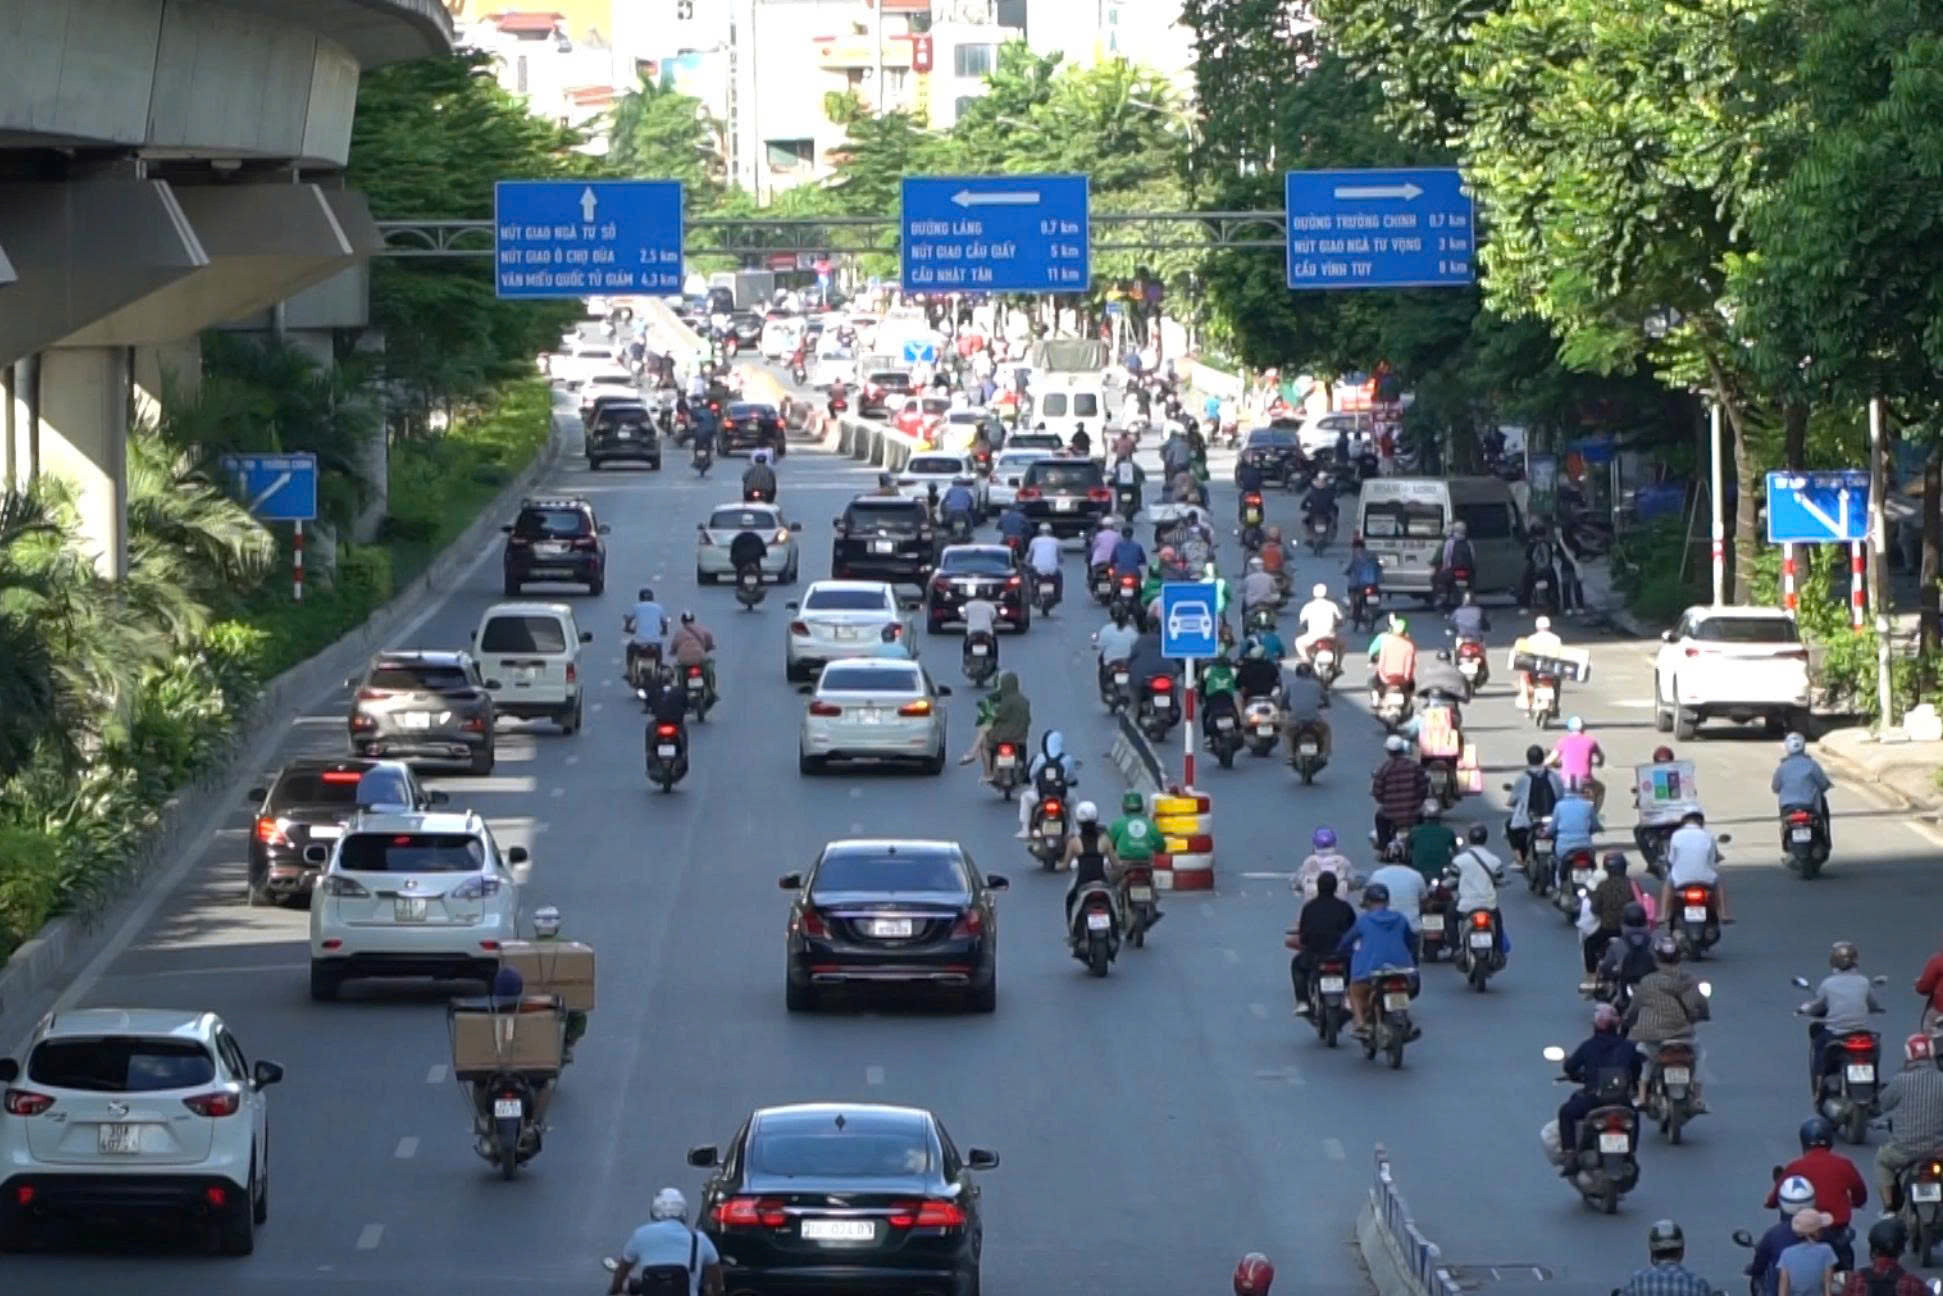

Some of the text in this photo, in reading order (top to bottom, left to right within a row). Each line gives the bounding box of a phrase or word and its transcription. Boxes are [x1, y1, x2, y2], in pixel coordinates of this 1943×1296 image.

[1449, 214, 1466, 227] km
[525, 227, 550, 240] GIAO
[1060, 221, 1078, 234] km
[1449, 238, 1467, 250] km
[526, 250, 550, 263] GIAO
[640, 250, 656, 263] 2.5
[660, 250, 678, 263] km
[936, 245, 962, 259] GIAO
[1062, 244, 1078, 258] km
[1450, 261, 1468, 274] km
[641, 274, 658, 286] 4.3
[660, 274, 678, 286] km
[1048, 268, 1058, 281] 11
[1062, 268, 1079, 281] km
